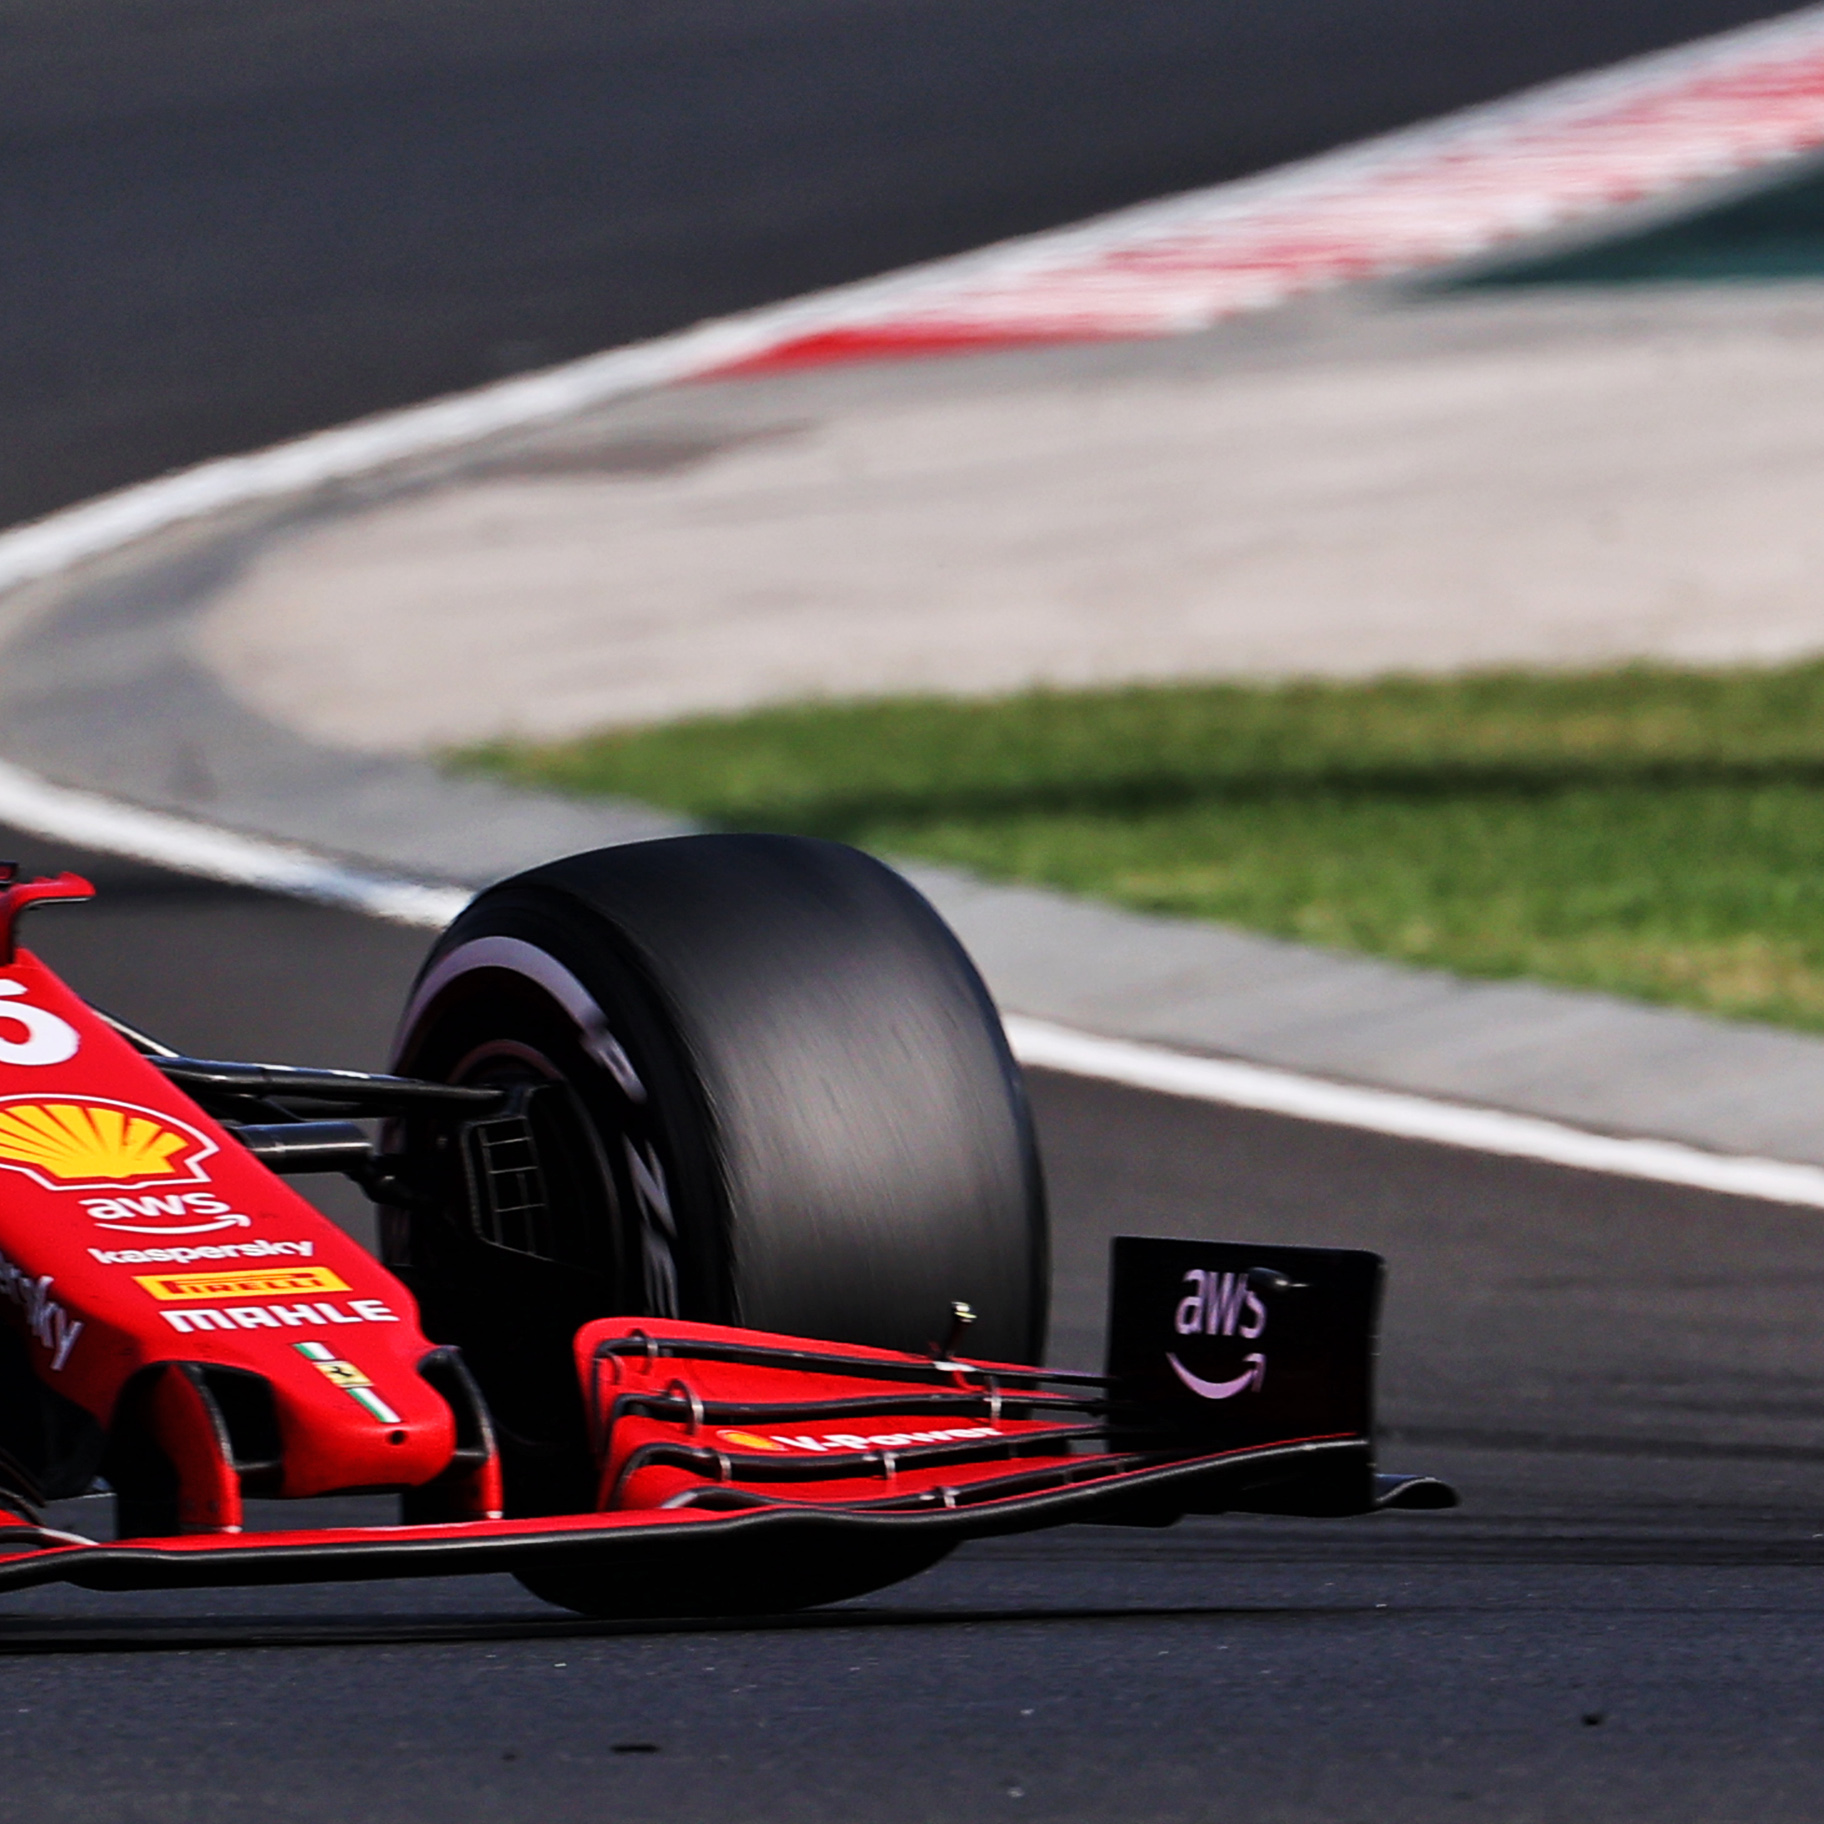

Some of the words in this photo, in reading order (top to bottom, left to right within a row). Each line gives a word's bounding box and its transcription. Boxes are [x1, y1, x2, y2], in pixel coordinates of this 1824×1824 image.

[77, 1191, 233, 1222] aws
[87, 1237, 314, 1265] kaspersky
[156, 1273, 325, 1295] PIRELLI
[159, 1299, 401, 1333] MAHLE
[1174, 1268, 1268, 1339] aws
[770, 1426, 1004, 1452] V-Power
